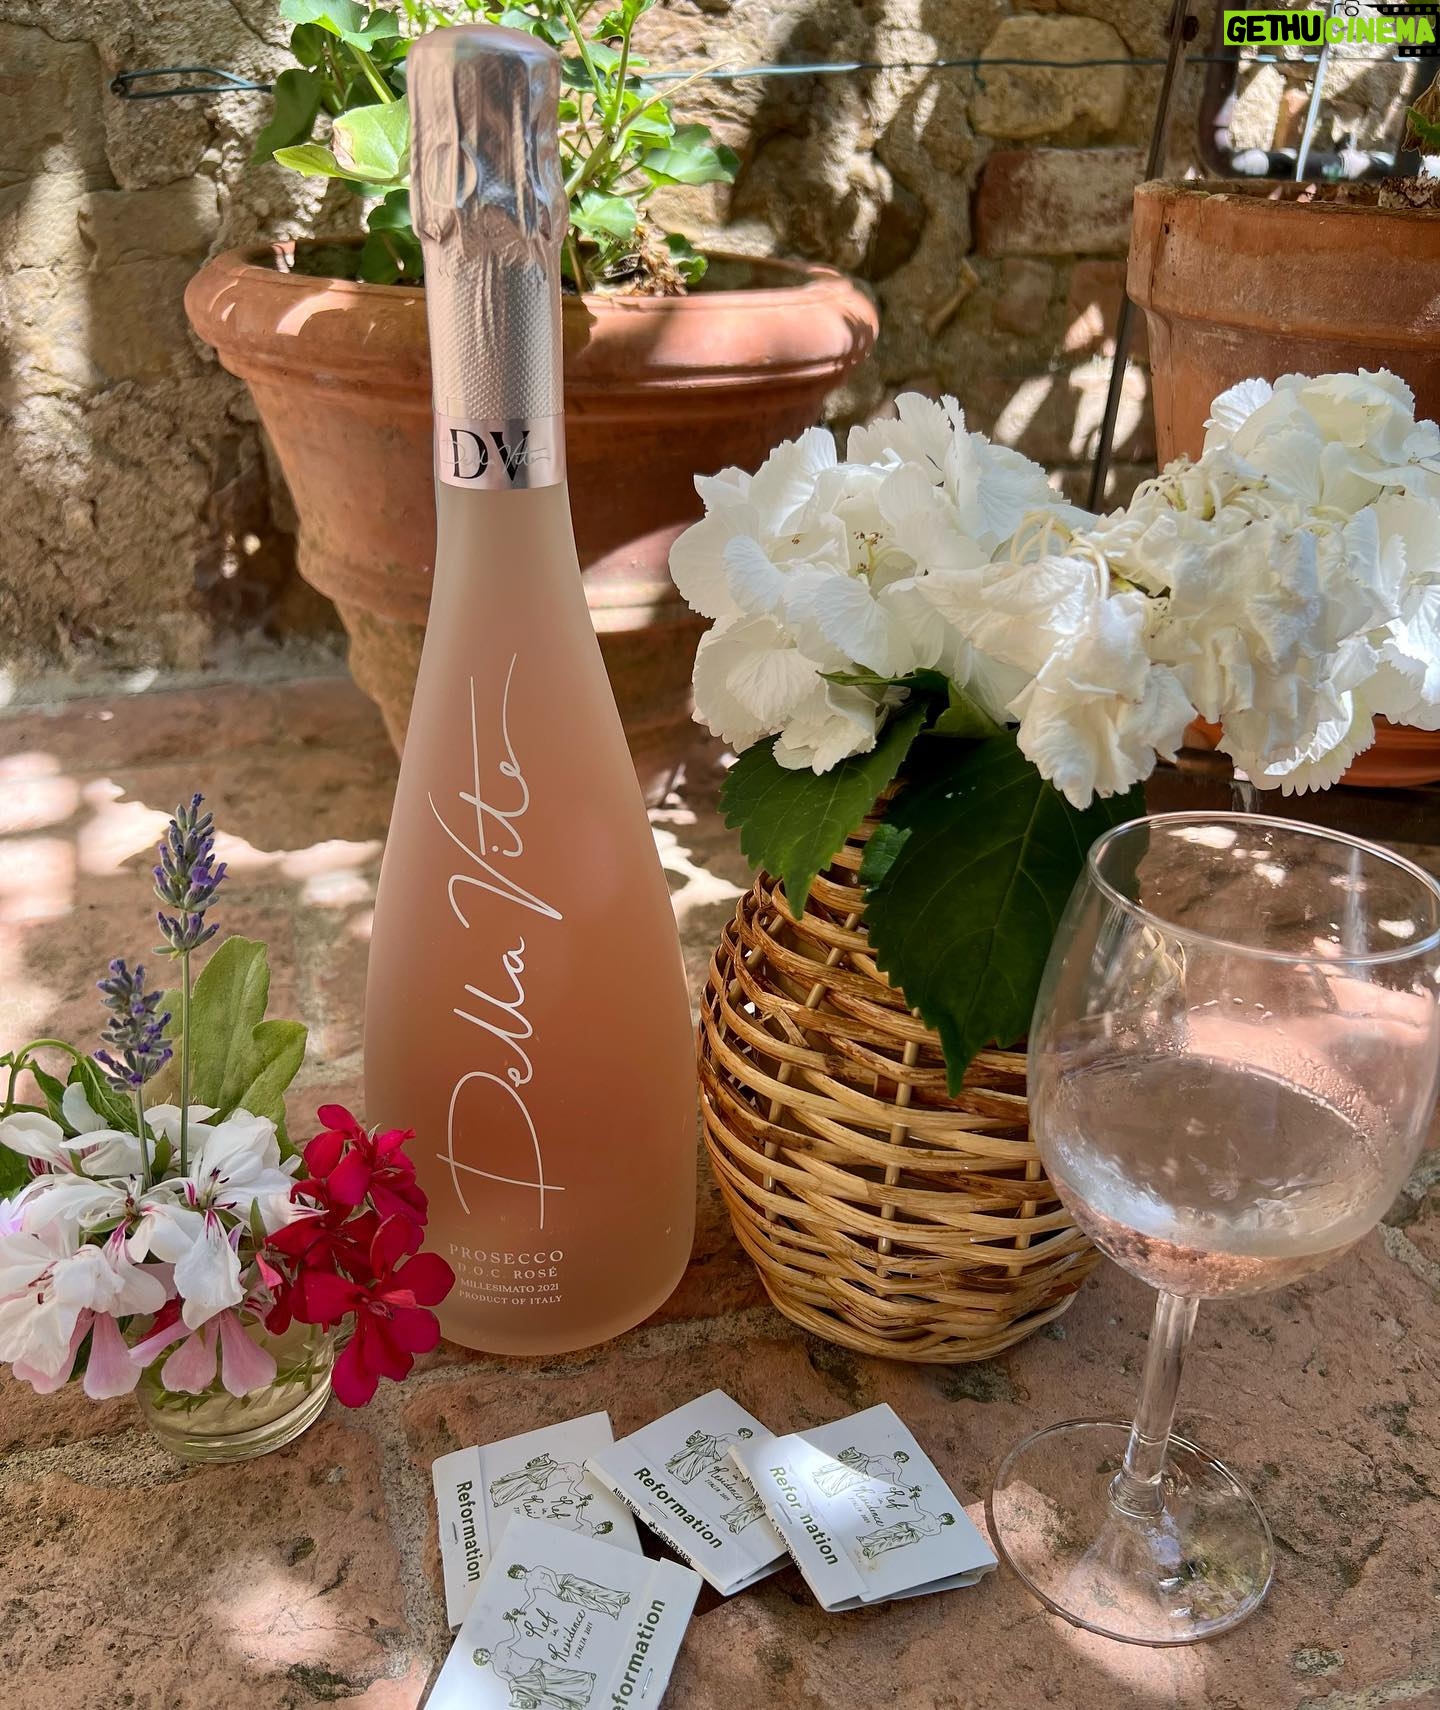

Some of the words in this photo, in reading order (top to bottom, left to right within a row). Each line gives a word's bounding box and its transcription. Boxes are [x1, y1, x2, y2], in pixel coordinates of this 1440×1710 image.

[449, 428, 530, 481] DV
[428, 652, 563, 928] Vite
[436, 936, 566, 1230] Della
[449, 1242, 564, 1265] PROSECCO
[513, 1266, 558, 1280] ROSÉ
[459, 1290, 508, 1304] PRODUCT
[530, 1295, 563, 1304] ITALY
[460, 1278, 535, 1293] MILLESIMATO
[537, 1283, 559, 1293] 2021
[456, 1480, 484, 1582] Reformation
[634, 1467, 723, 1549] Reformation
[524, 1607, 557, 1638] Ref
[548, 1609, 586, 1662] Residence
[612, 1599, 666, 1710] eformation
